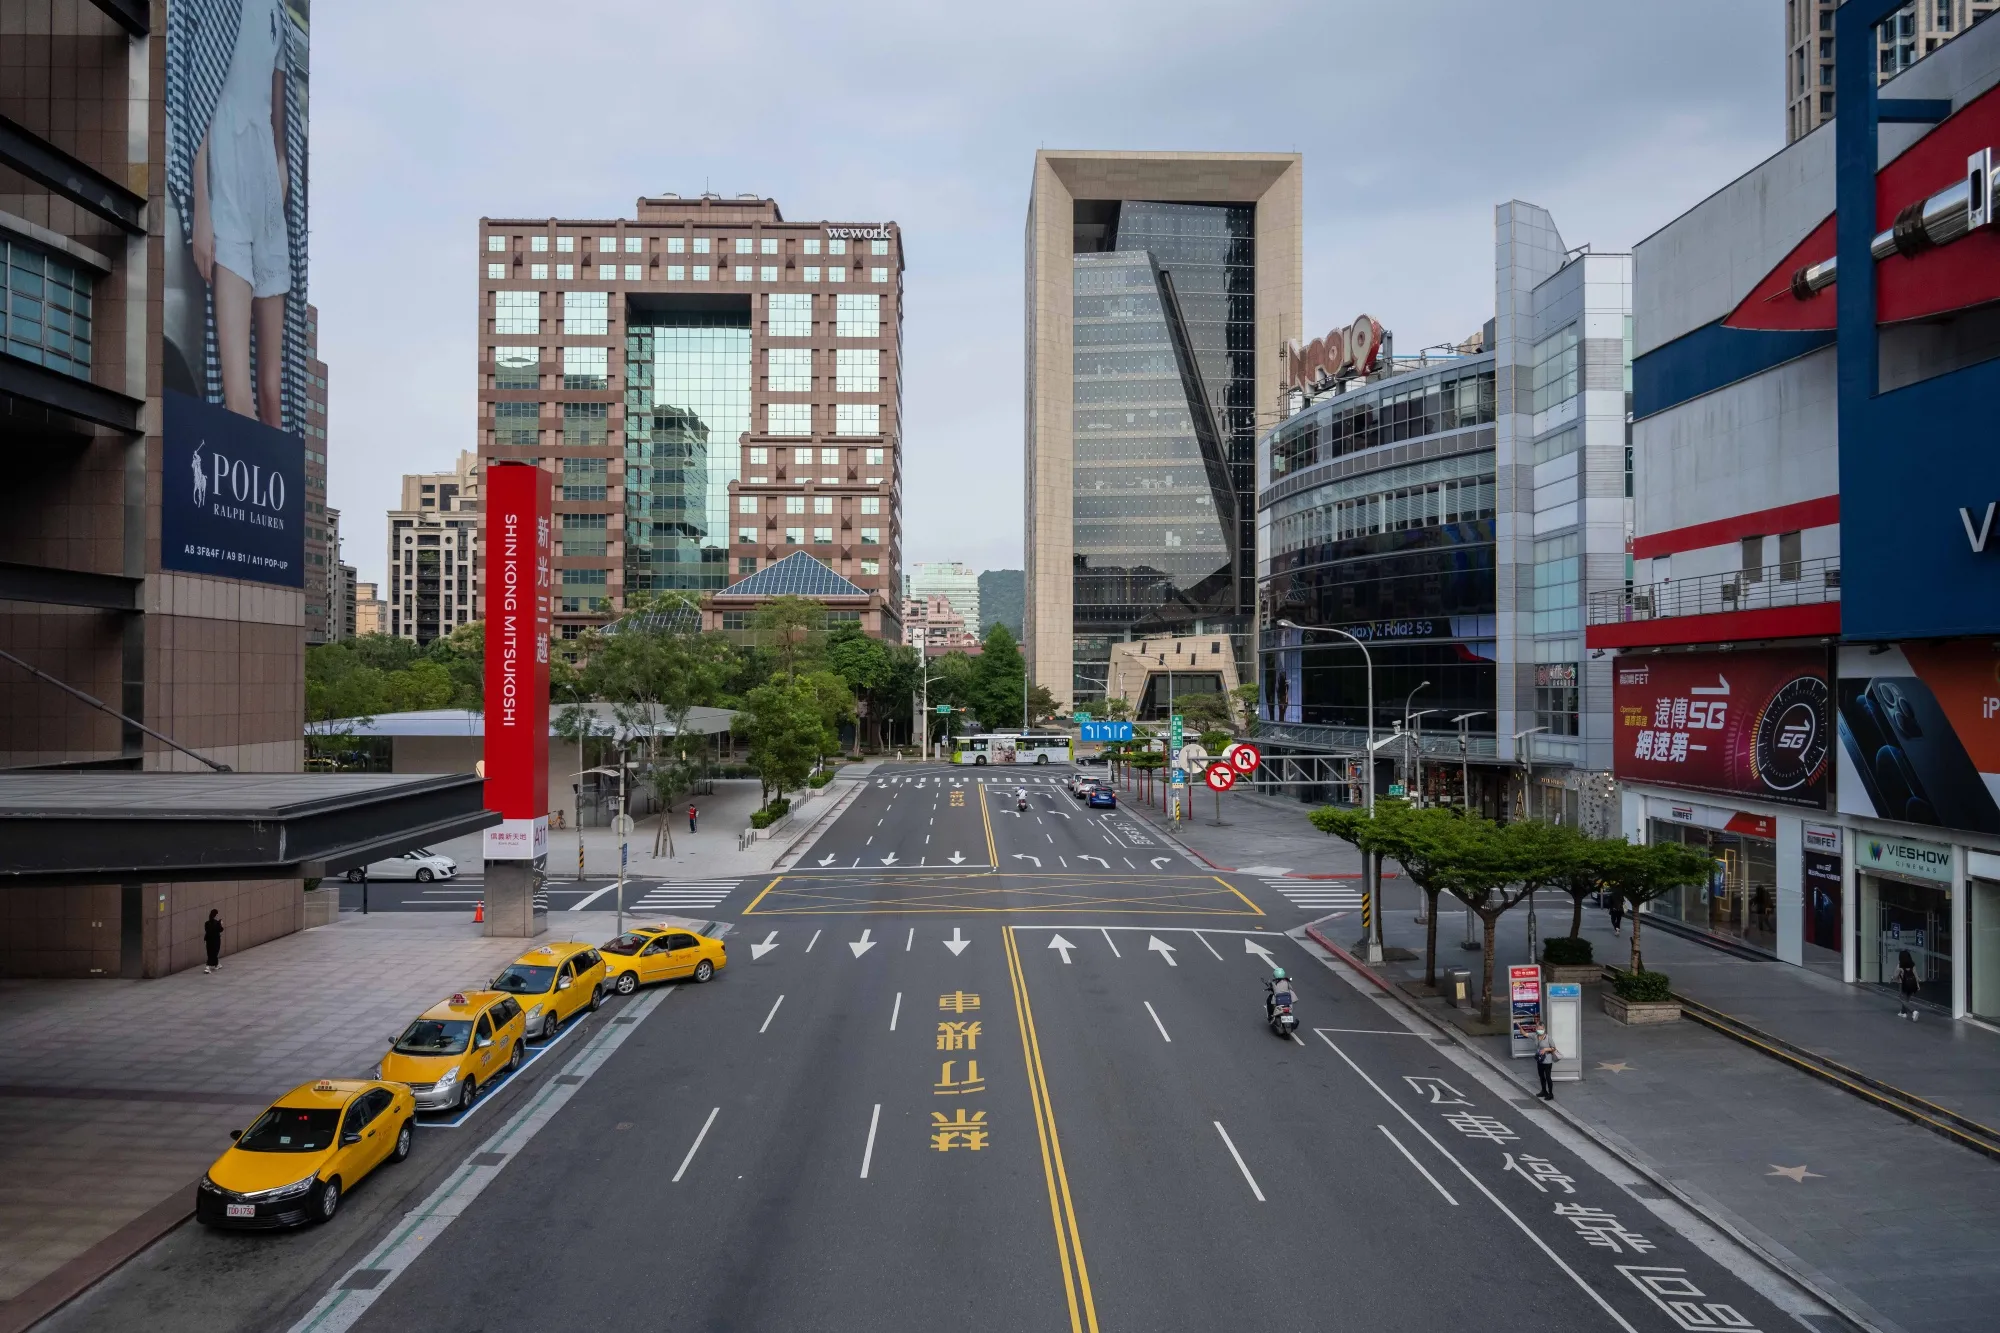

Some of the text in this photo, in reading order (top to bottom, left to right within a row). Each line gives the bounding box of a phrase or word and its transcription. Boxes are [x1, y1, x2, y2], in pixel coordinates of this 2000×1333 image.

[826, 223, 892, 239] wework
[212, 452, 285, 511] POLO
[213, 503, 284, 530] RALPH LAUREN
[1959, 502, 1996, 552] V
[184, 544, 289, 570] A8 3F&4F / A9 B1 / A11 POP-UP
[536, 516, 549, 664] 新光三越
[503, 514, 517, 726] SHIN KONG MITSUKOSHI
[1384, 622, 1414, 636] Fold2
[1416, 621, 1433, 635] 5G
[1634, 729, 1708, 763] 網速第一
[1777, 732, 1807, 748] 5G
[534, 825, 546, 847] A11
[1821, 837, 1836, 848] FET
[1886, 843, 1949, 866] VIESHOW
[1895, 860, 1937, 874] CINEMAS
[1402, 1075, 1764, 1333] 公車停靠區
